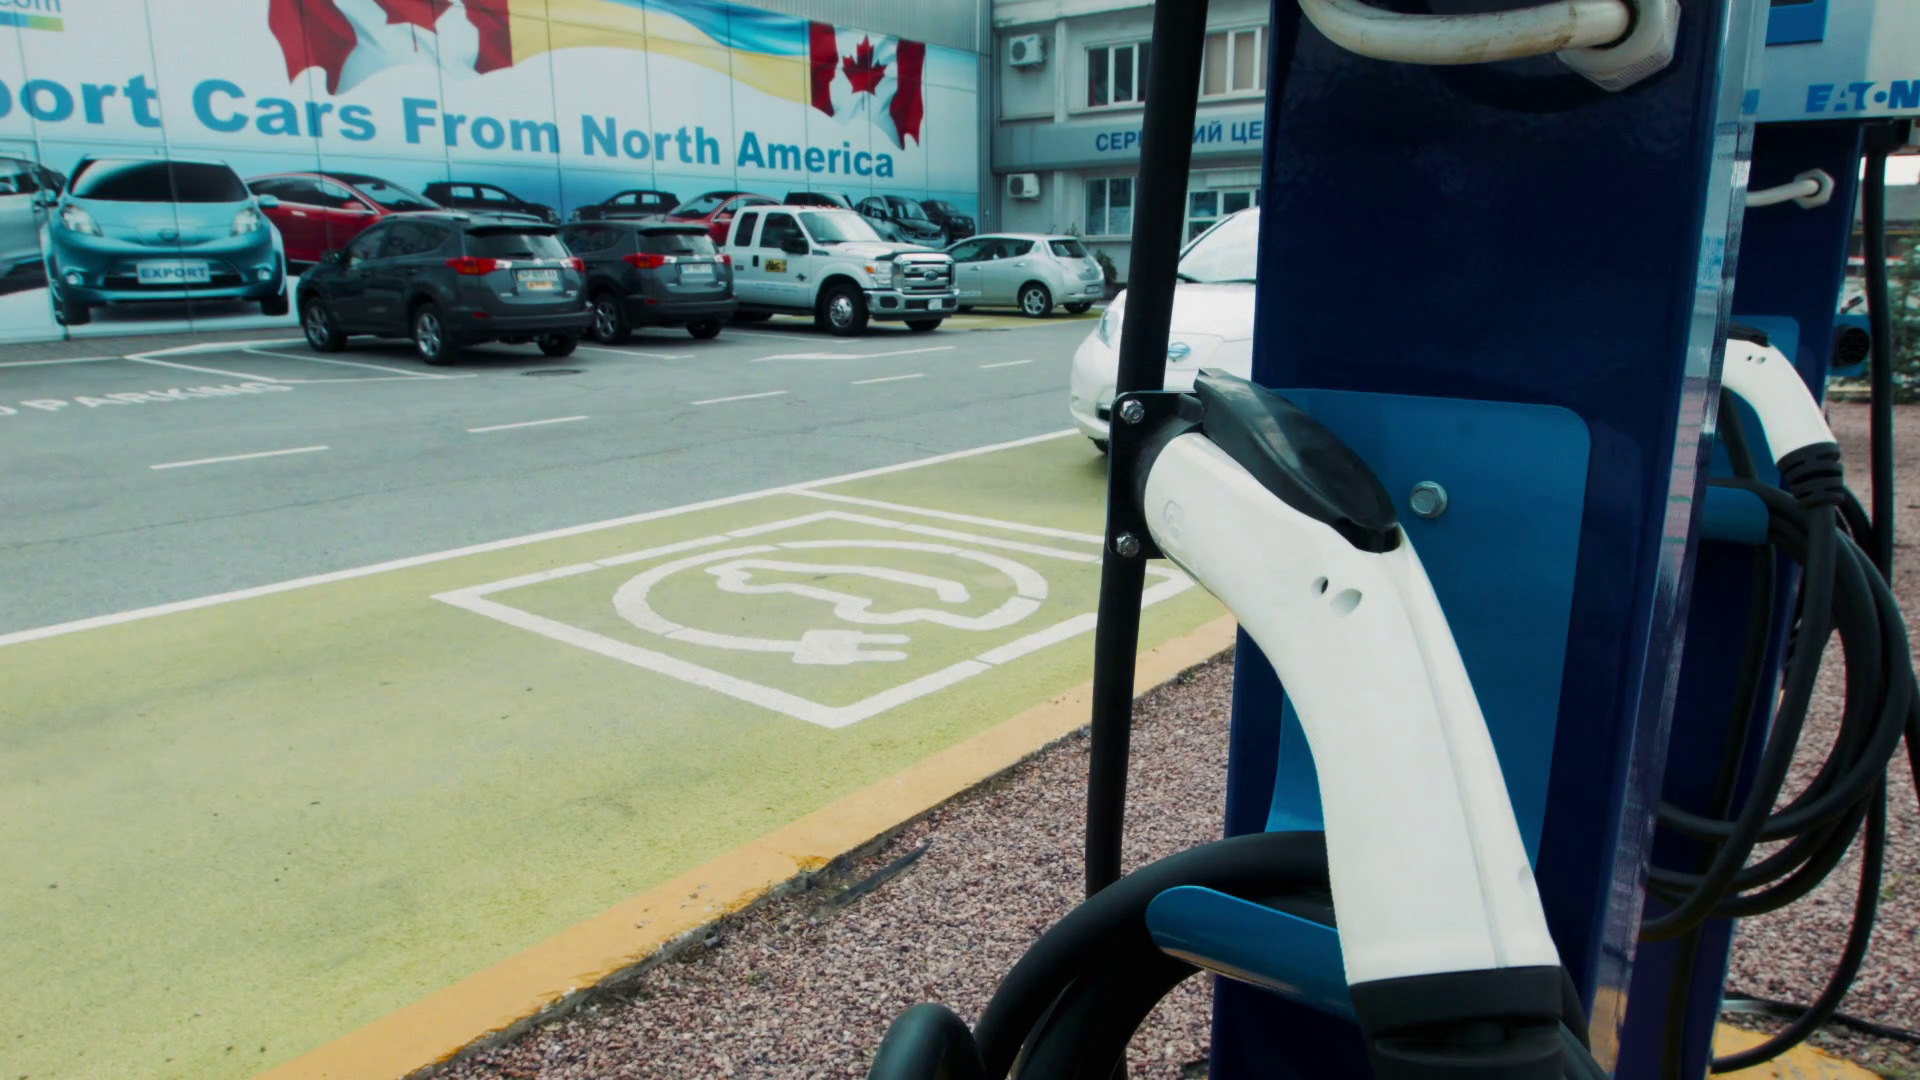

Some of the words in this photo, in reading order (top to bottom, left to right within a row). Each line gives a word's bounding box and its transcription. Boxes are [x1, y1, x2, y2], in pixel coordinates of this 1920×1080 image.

[0, 74, 163, 128] ort
[192, 79, 376, 141] Cars
[403, 97, 560, 154] From
[581, 114, 720, 165] North
[737, 131, 895, 178] America
[140, 266, 207, 279] EXPORT
